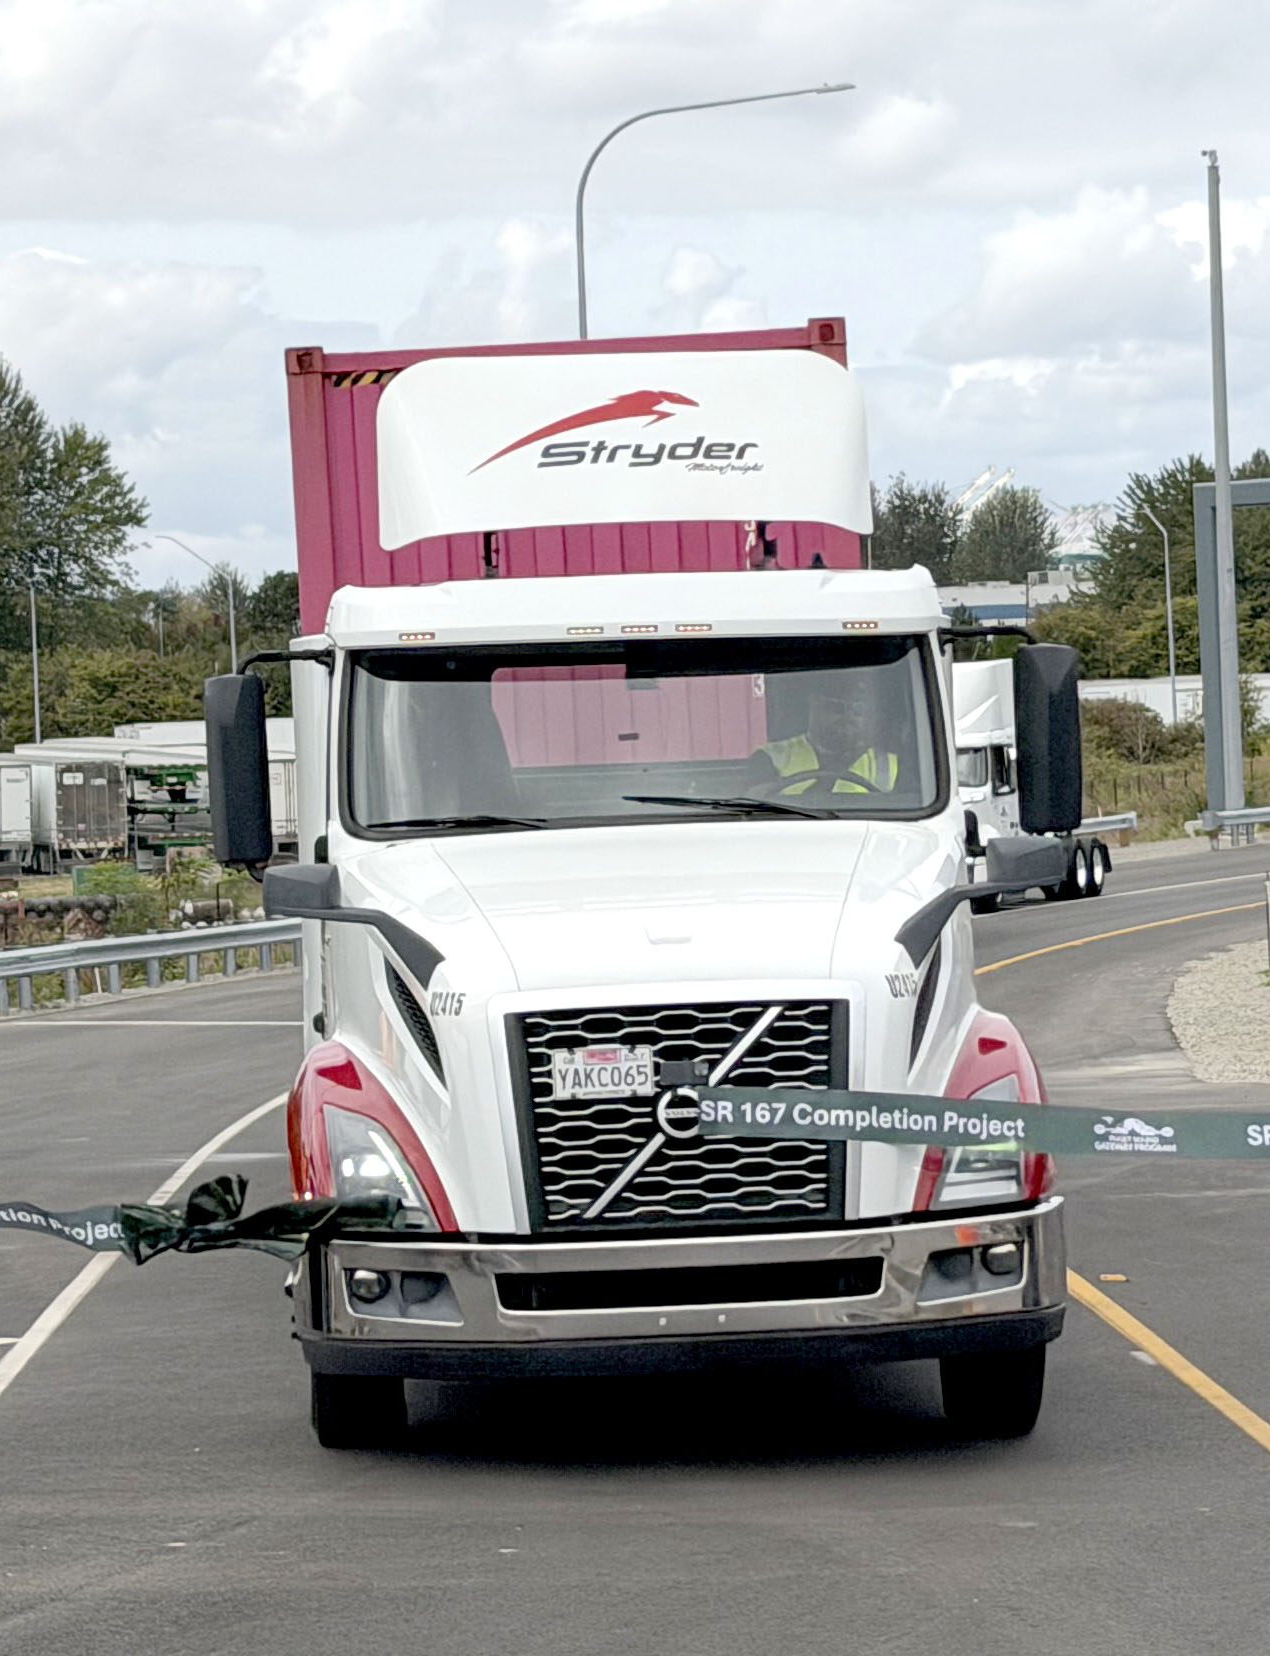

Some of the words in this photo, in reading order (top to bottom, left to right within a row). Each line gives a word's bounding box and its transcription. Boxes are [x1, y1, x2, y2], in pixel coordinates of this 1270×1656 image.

[537, 436, 759, 469] Stryder
[558, 1064, 650, 1090] YAKC065
[700, 1099, 734, 1123] SR
[740, 1102, 787, 1125] 167
[792, 1102, 937, 1132] Completion
[943, 1111, 1026, 1140] Project
